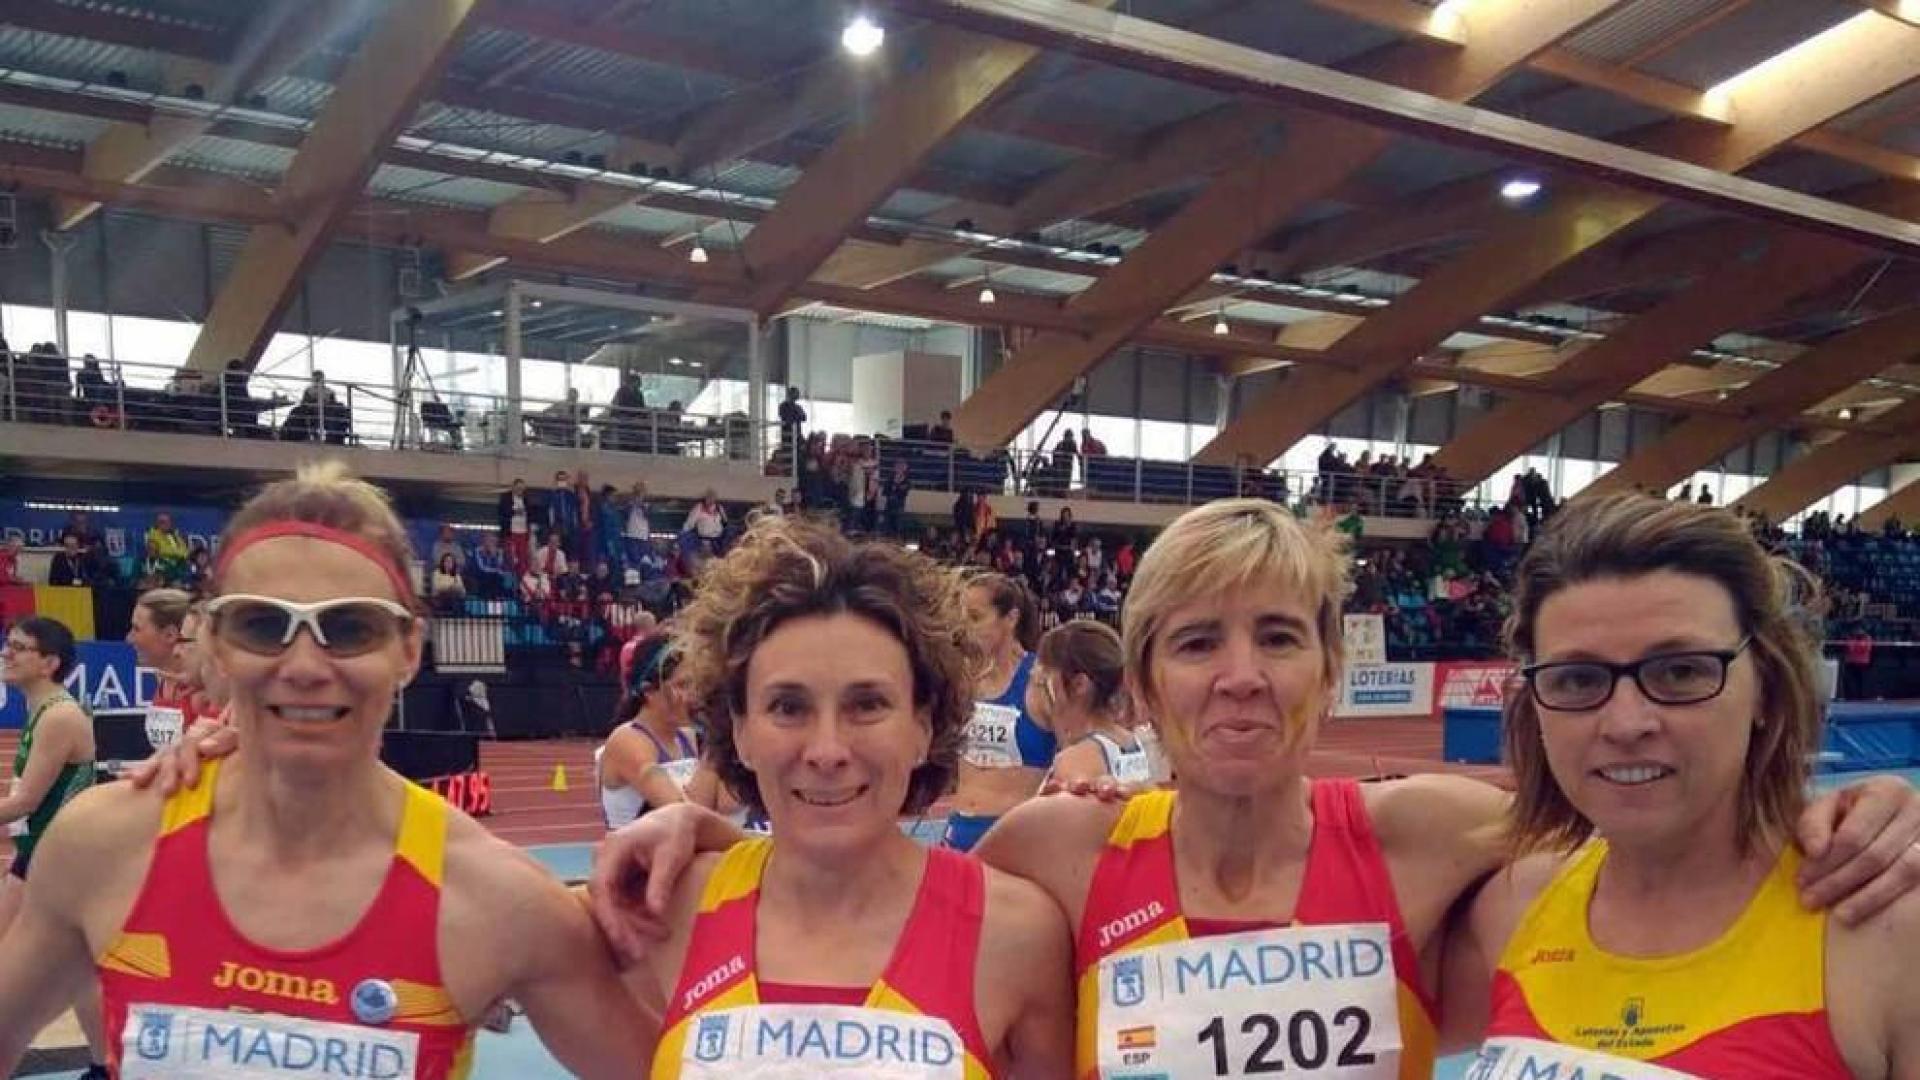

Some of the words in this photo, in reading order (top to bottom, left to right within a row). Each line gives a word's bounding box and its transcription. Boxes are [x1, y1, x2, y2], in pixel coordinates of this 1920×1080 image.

[1174, 938, 1385, 994] MADRID
[201, 1022, 405, 1080] MADRID
[756, 1018, 955, 1066] MADRID
[1122, 1052, 1151, 1066] ESP
[1197, 1005, 1377, 1078] 1202
